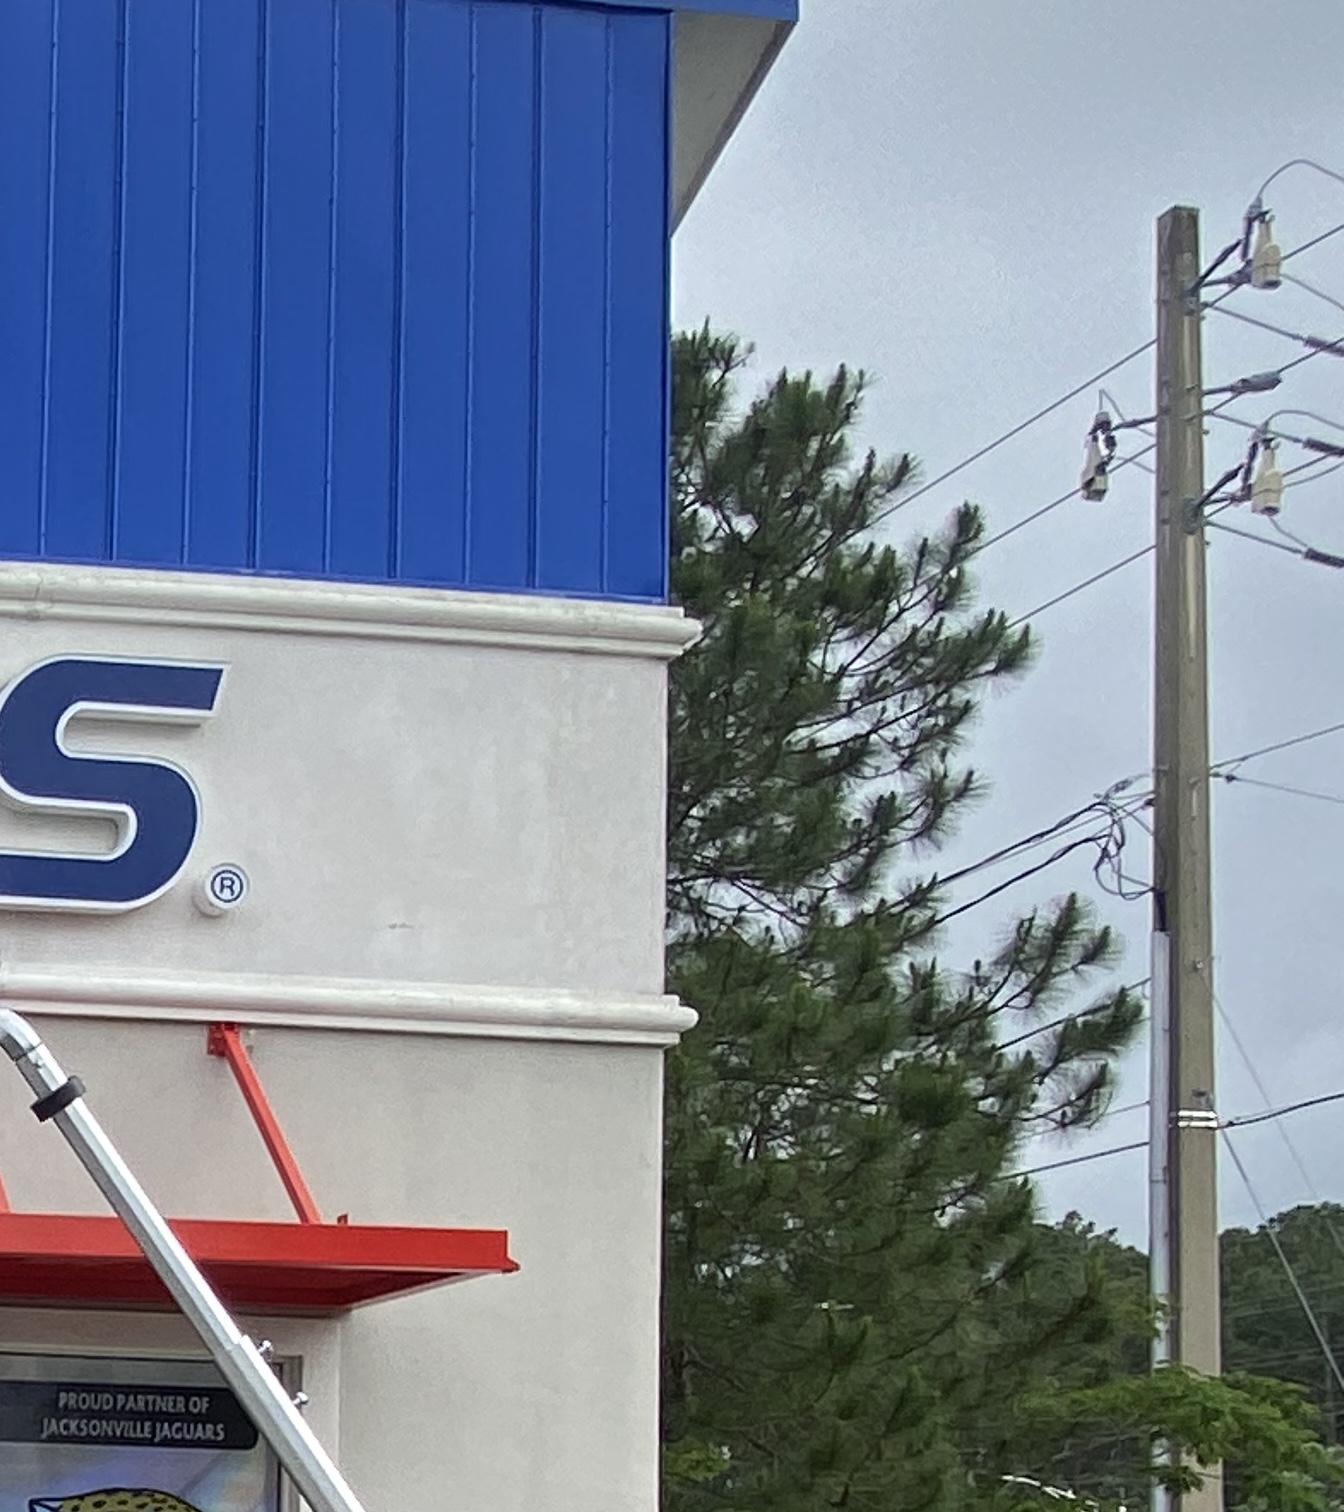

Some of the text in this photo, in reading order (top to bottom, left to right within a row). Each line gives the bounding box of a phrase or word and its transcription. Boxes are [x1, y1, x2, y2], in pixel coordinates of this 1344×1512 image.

[58, 1391, 210, 1414] PROUD PARTNER OF
[41, 1417, 226, 1442] JACKSONVILLE JAGUARS
